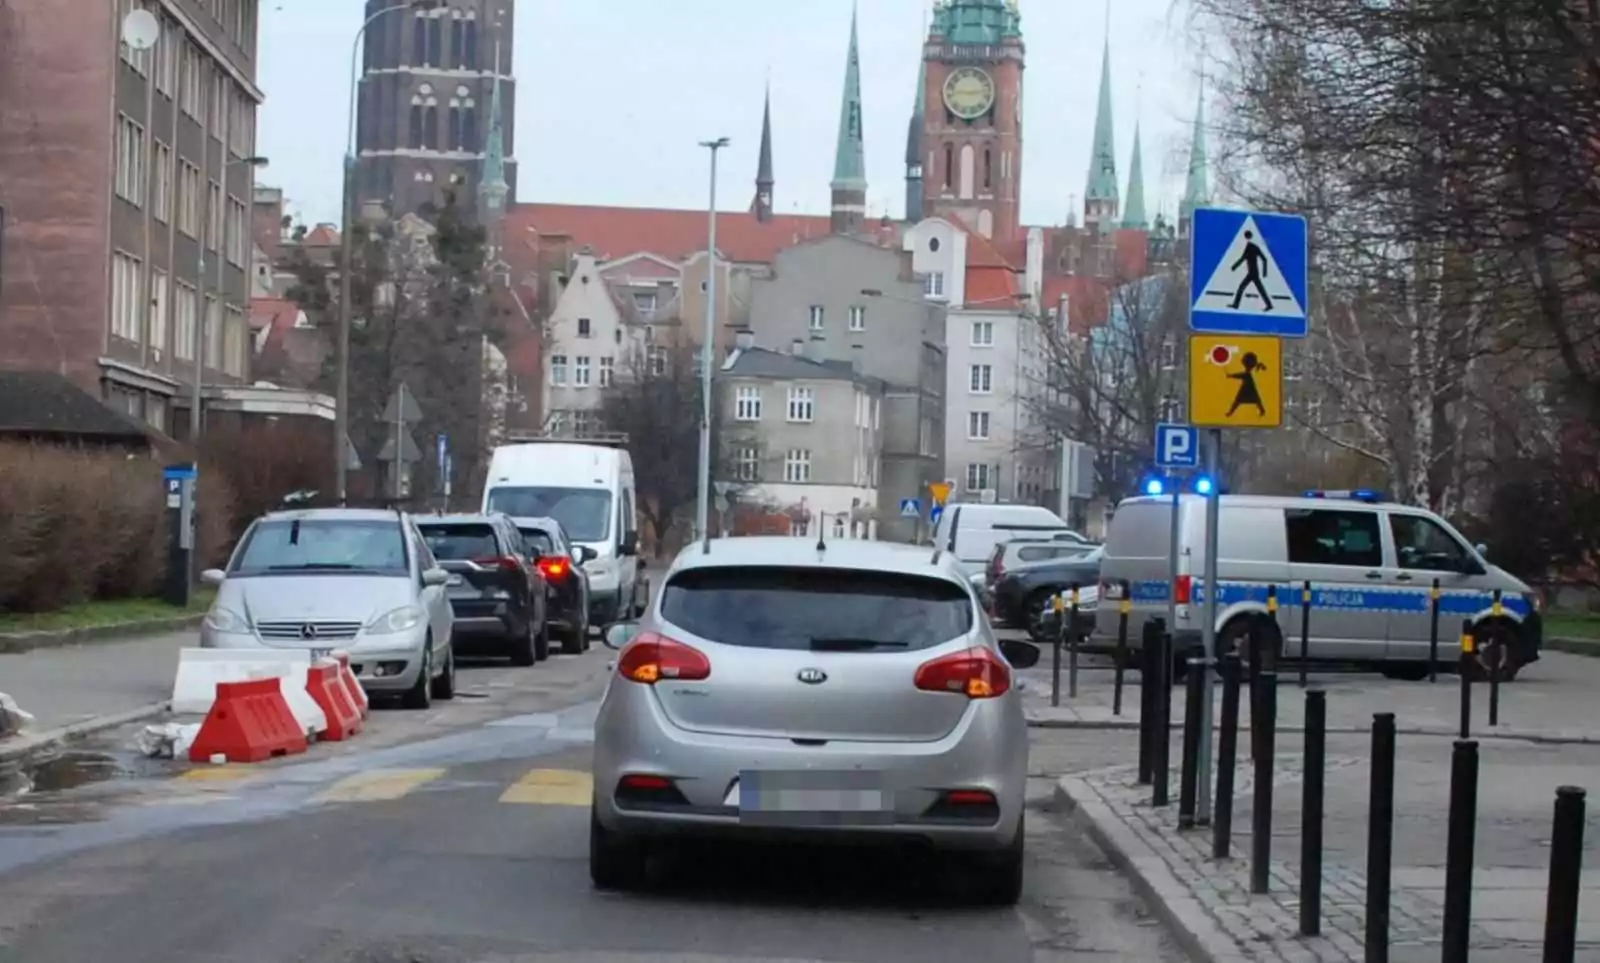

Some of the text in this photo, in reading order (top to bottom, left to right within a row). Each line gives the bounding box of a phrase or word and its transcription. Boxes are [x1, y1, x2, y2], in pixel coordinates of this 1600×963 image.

[1164, 429, 1189, 462] P
[1319, 592, 1364, 605] POLICJA
[801, 669, 823, 680] KIA
